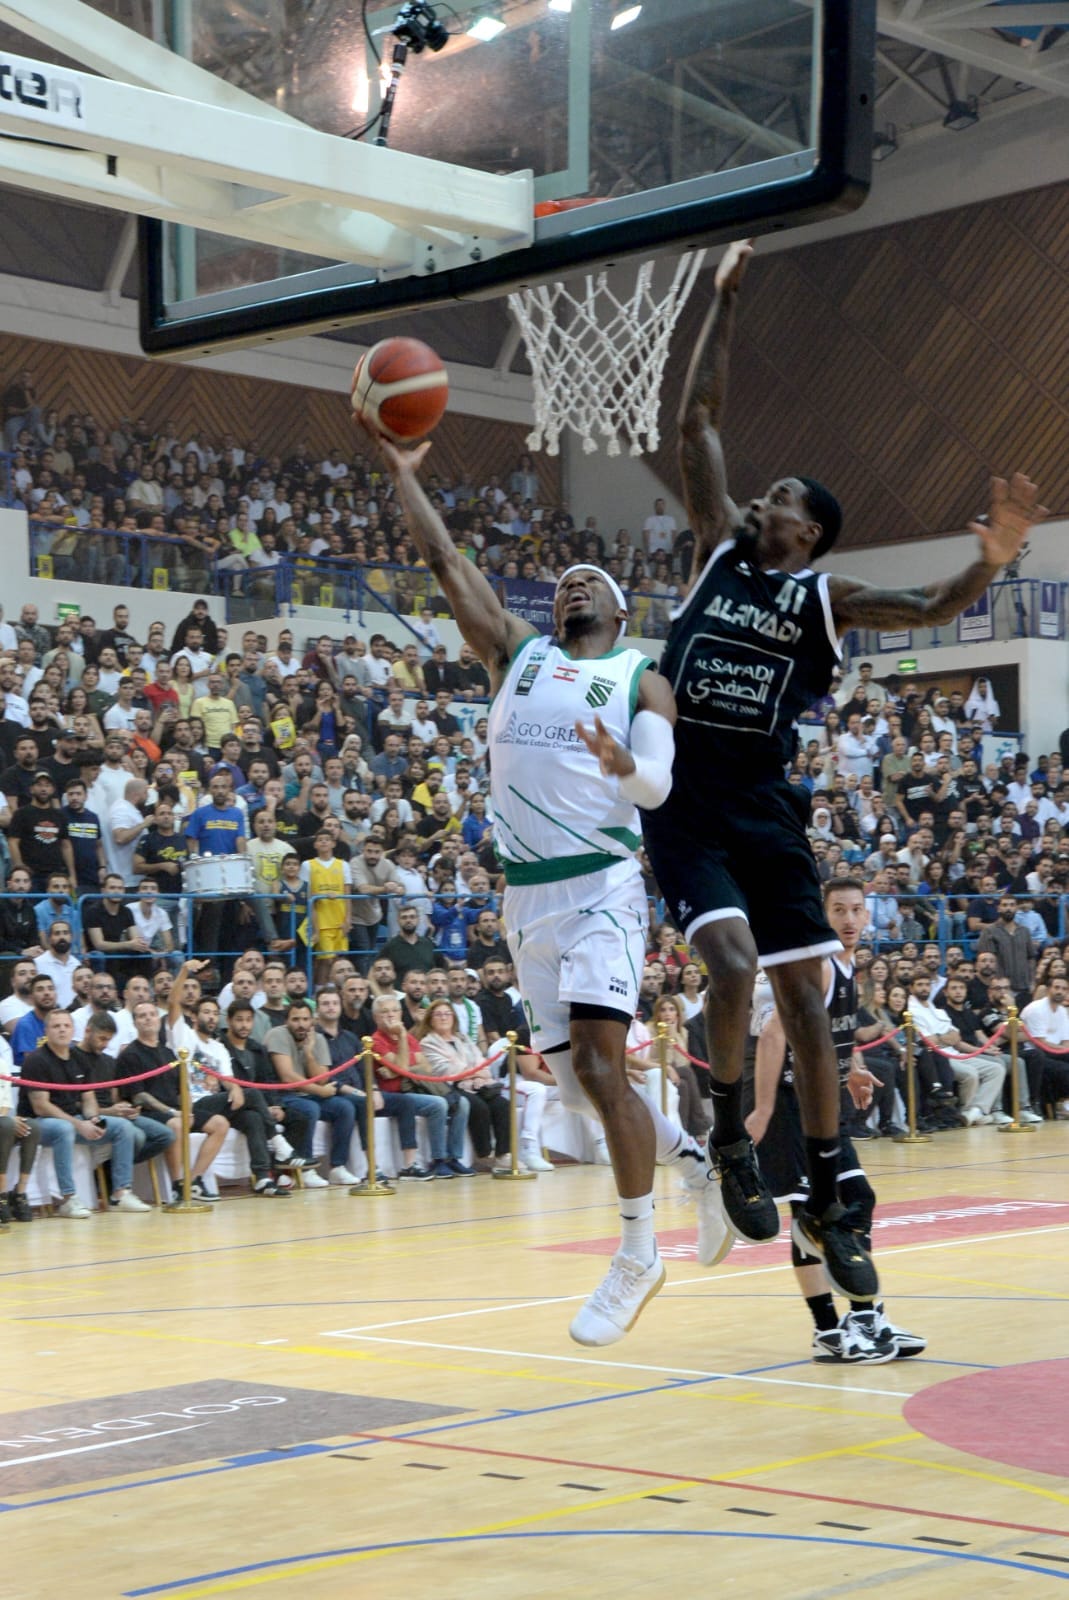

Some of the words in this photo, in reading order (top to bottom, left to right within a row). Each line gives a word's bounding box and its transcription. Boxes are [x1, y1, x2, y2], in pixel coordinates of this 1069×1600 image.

[774, 579, 808, 615] 41
[686, 678, 769, 704] الصفدي
[517, 722, 542, 738] GO
